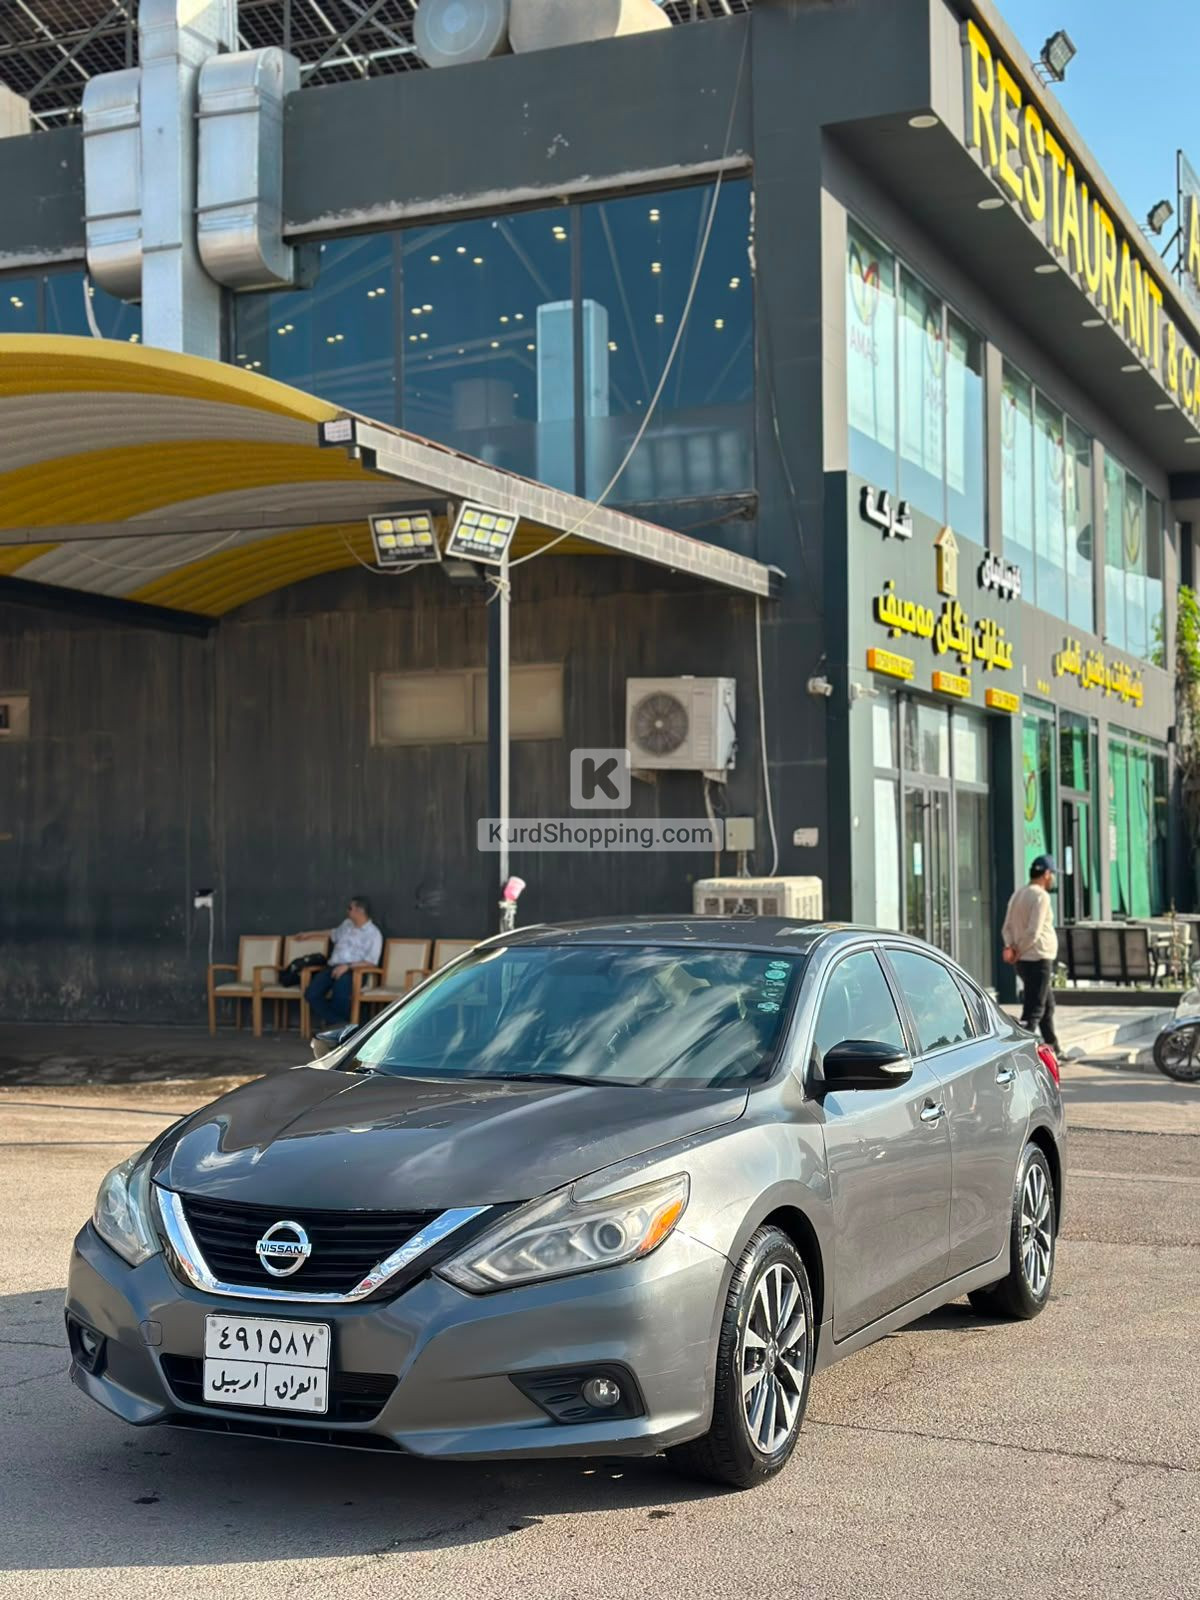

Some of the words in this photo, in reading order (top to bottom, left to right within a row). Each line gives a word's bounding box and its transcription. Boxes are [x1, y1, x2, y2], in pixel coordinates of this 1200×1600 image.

[967, 19, 1163, 370] RESTAURANT
[1168, 321, 1178, 394] &
[258, 1242, 304, 1254] NISSAN
[218, 1326, 315, 1357] ٤٩١٥٨٧
